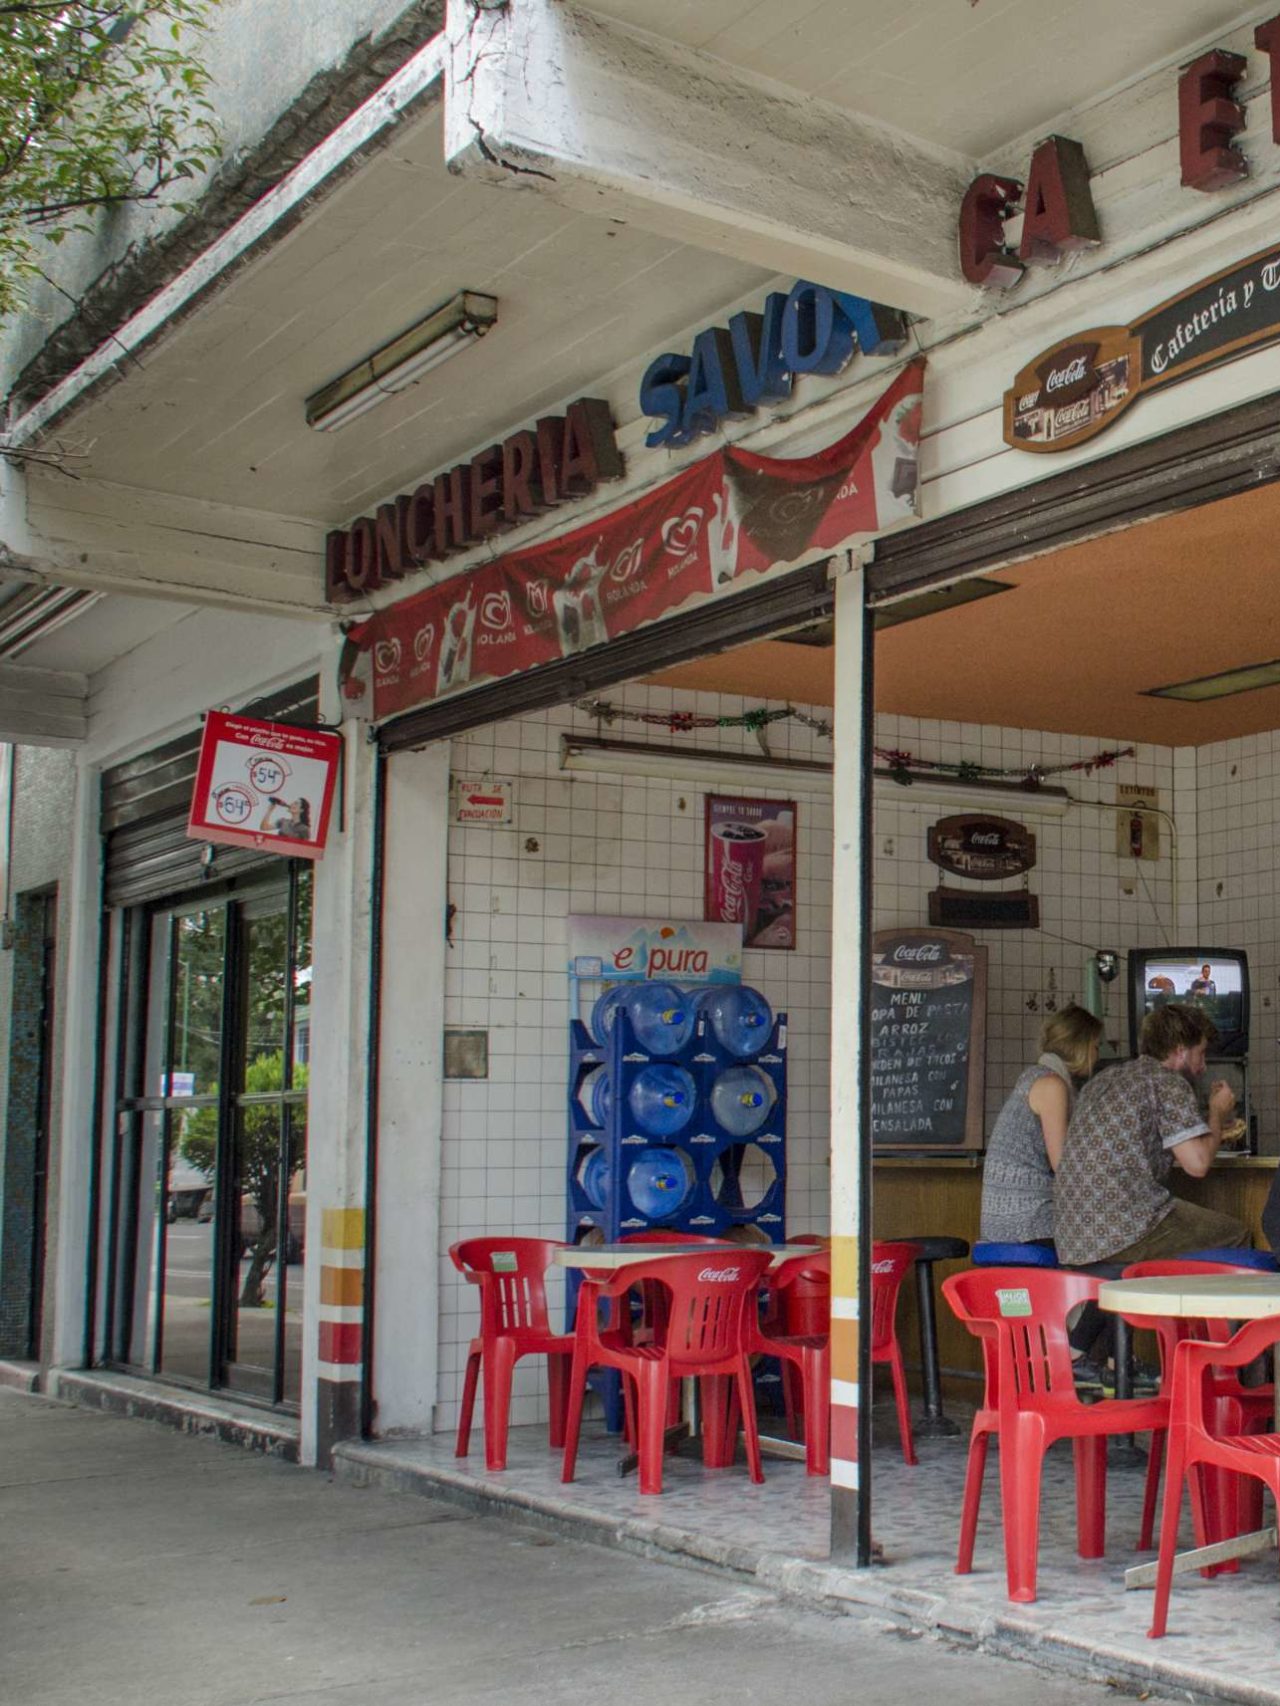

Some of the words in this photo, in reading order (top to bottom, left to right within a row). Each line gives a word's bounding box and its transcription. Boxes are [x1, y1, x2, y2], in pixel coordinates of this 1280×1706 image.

[1243, 280, 1254, 308] y
[1046, 355, 1088, 392] Coca-Cola
[326, 396, 628, 605] LONCHERIA
[640, 278, 912, 450] SAVOY
[250, 733, 287, 750] Coca-Cola
[971, 831, 1000, 845] Coca-Cola
[893, 944, 941, 962] Coca-Cola
[872, 1008, 896, 1021] OPA
[906, 1006, 920, 1019] DE
[880, 1022, 929, 1036] ARROZ
[883, 1084, 919, 1099] PAPAS
[934, 1098, 954, 1112] CON
[873, 1117, 933, 1133] ENSALADA
[697, 1266, 741, 1283] Coca-Cola
